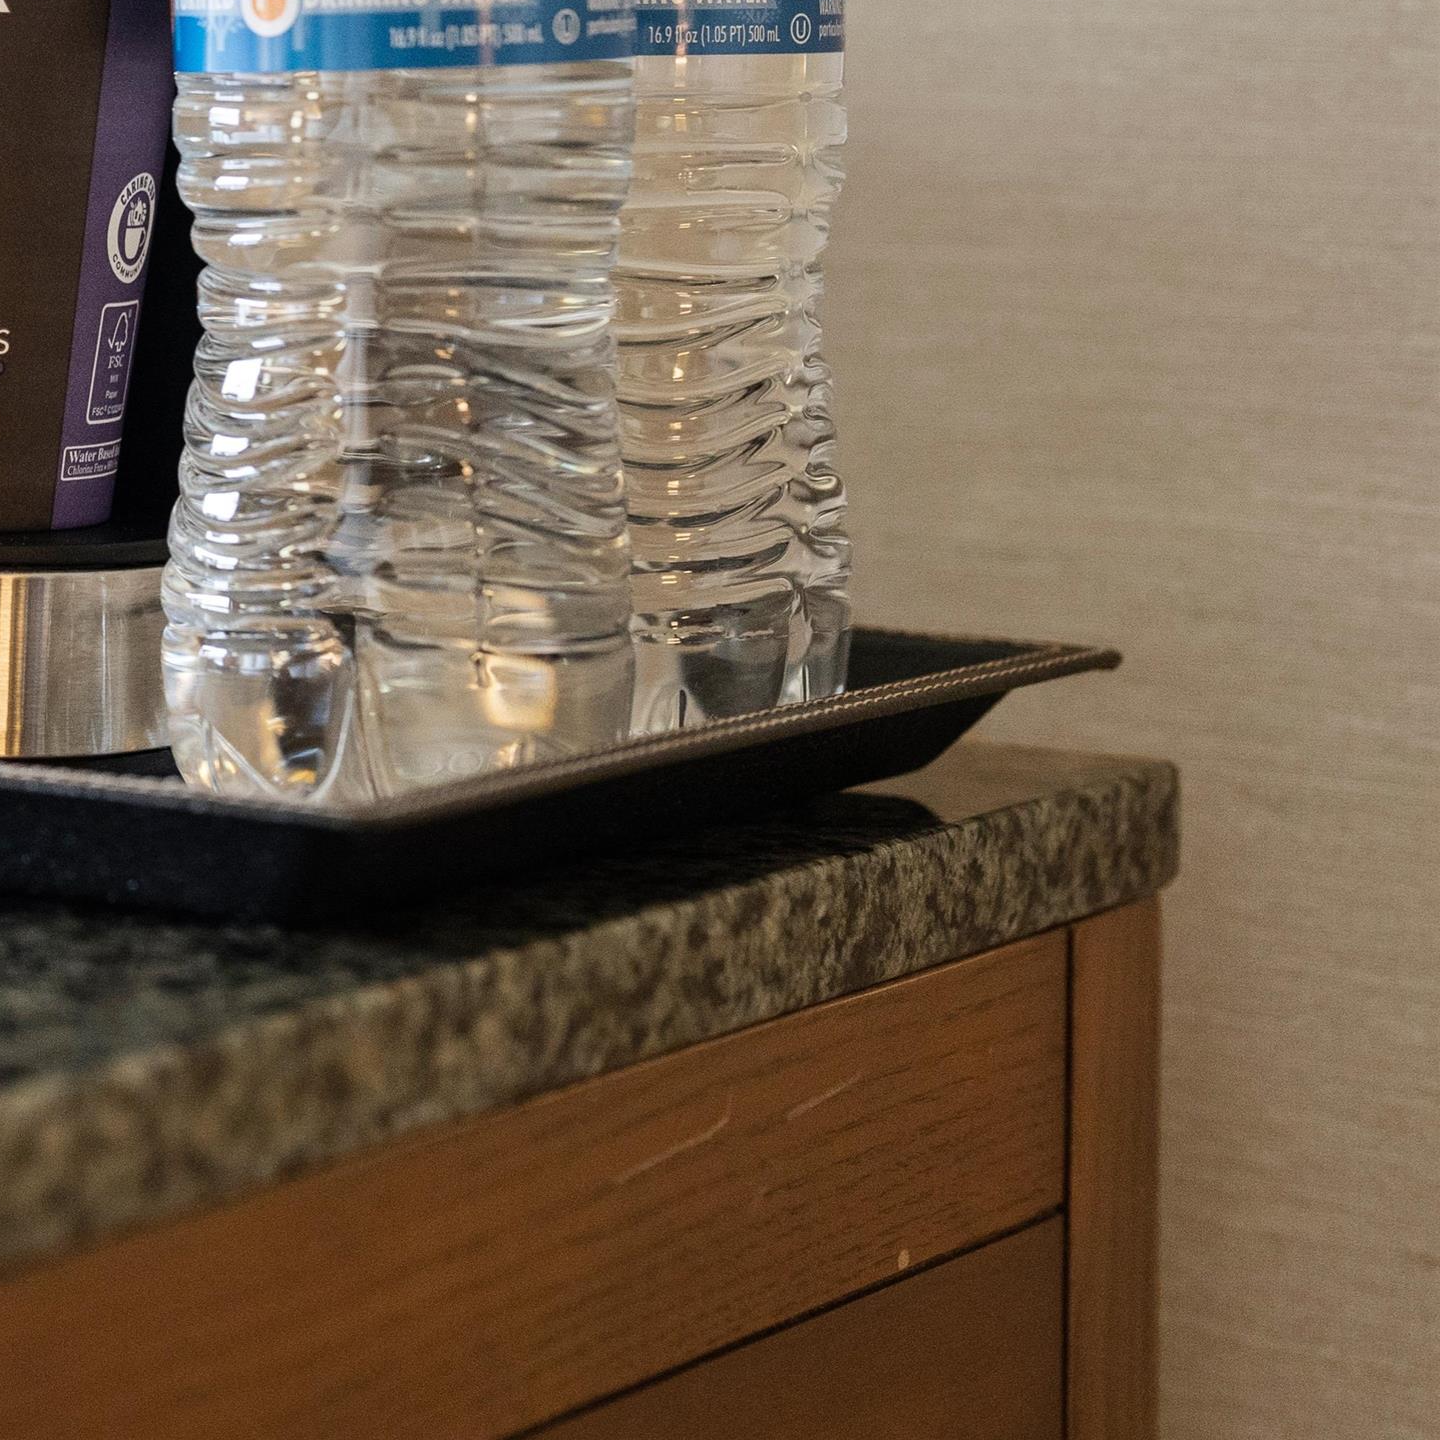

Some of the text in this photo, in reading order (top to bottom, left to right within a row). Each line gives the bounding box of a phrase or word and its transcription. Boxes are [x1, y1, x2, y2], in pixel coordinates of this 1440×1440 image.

[648, 26, 671, 44] 16.9
[686, 30, 698, 43] oz
[700, 24, 727, 47] (1.05
[729, 24, 746, 47] PT)
[748, 25, 767, 43] 500
[69, 449, 96, 464] Water
